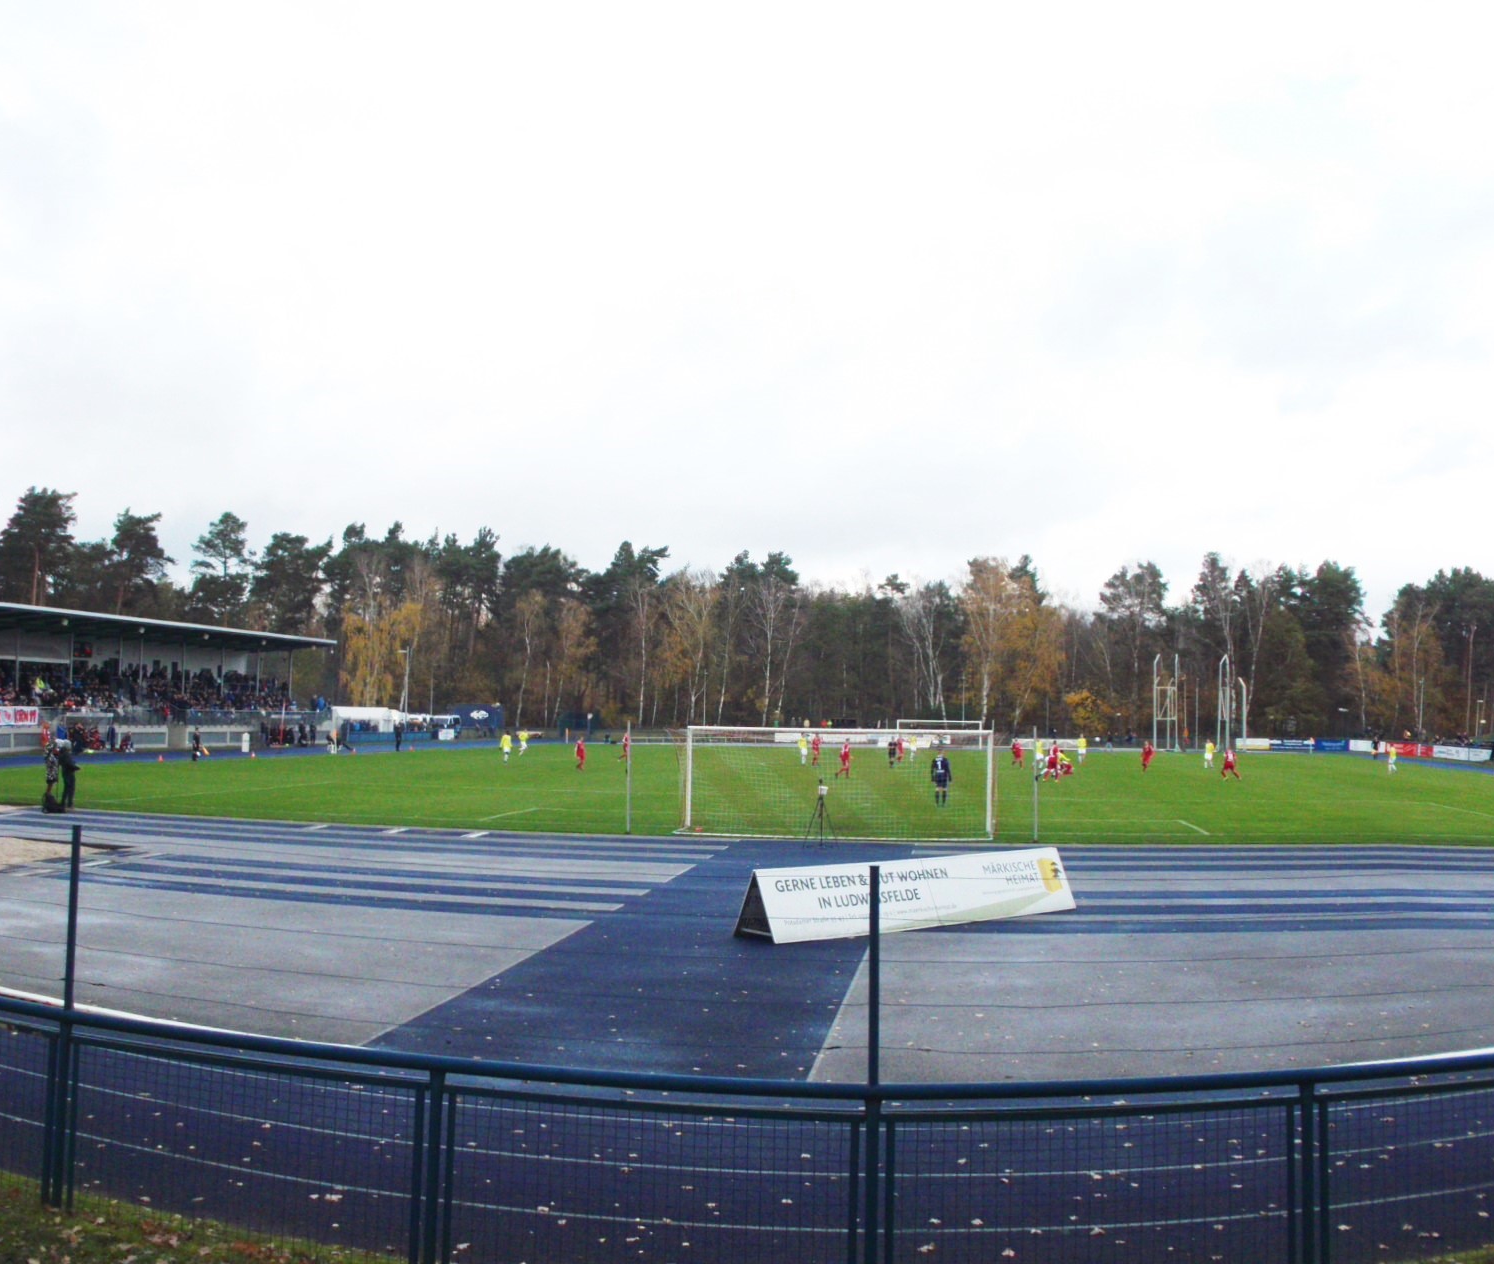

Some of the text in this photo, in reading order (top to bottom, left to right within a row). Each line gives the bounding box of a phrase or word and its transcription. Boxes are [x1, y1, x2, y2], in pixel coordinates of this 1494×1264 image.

[936, 761, 942, 770] 1
[982, 860, 1037, 875] MÄRKISCHE
[775, 867, 948, 893] GERNE LEBEN & UT WOHNEN
[1005, 873, 1039, 886] HEIMAT
[818, 888, 921, 909] IN LUDWSFELDE
